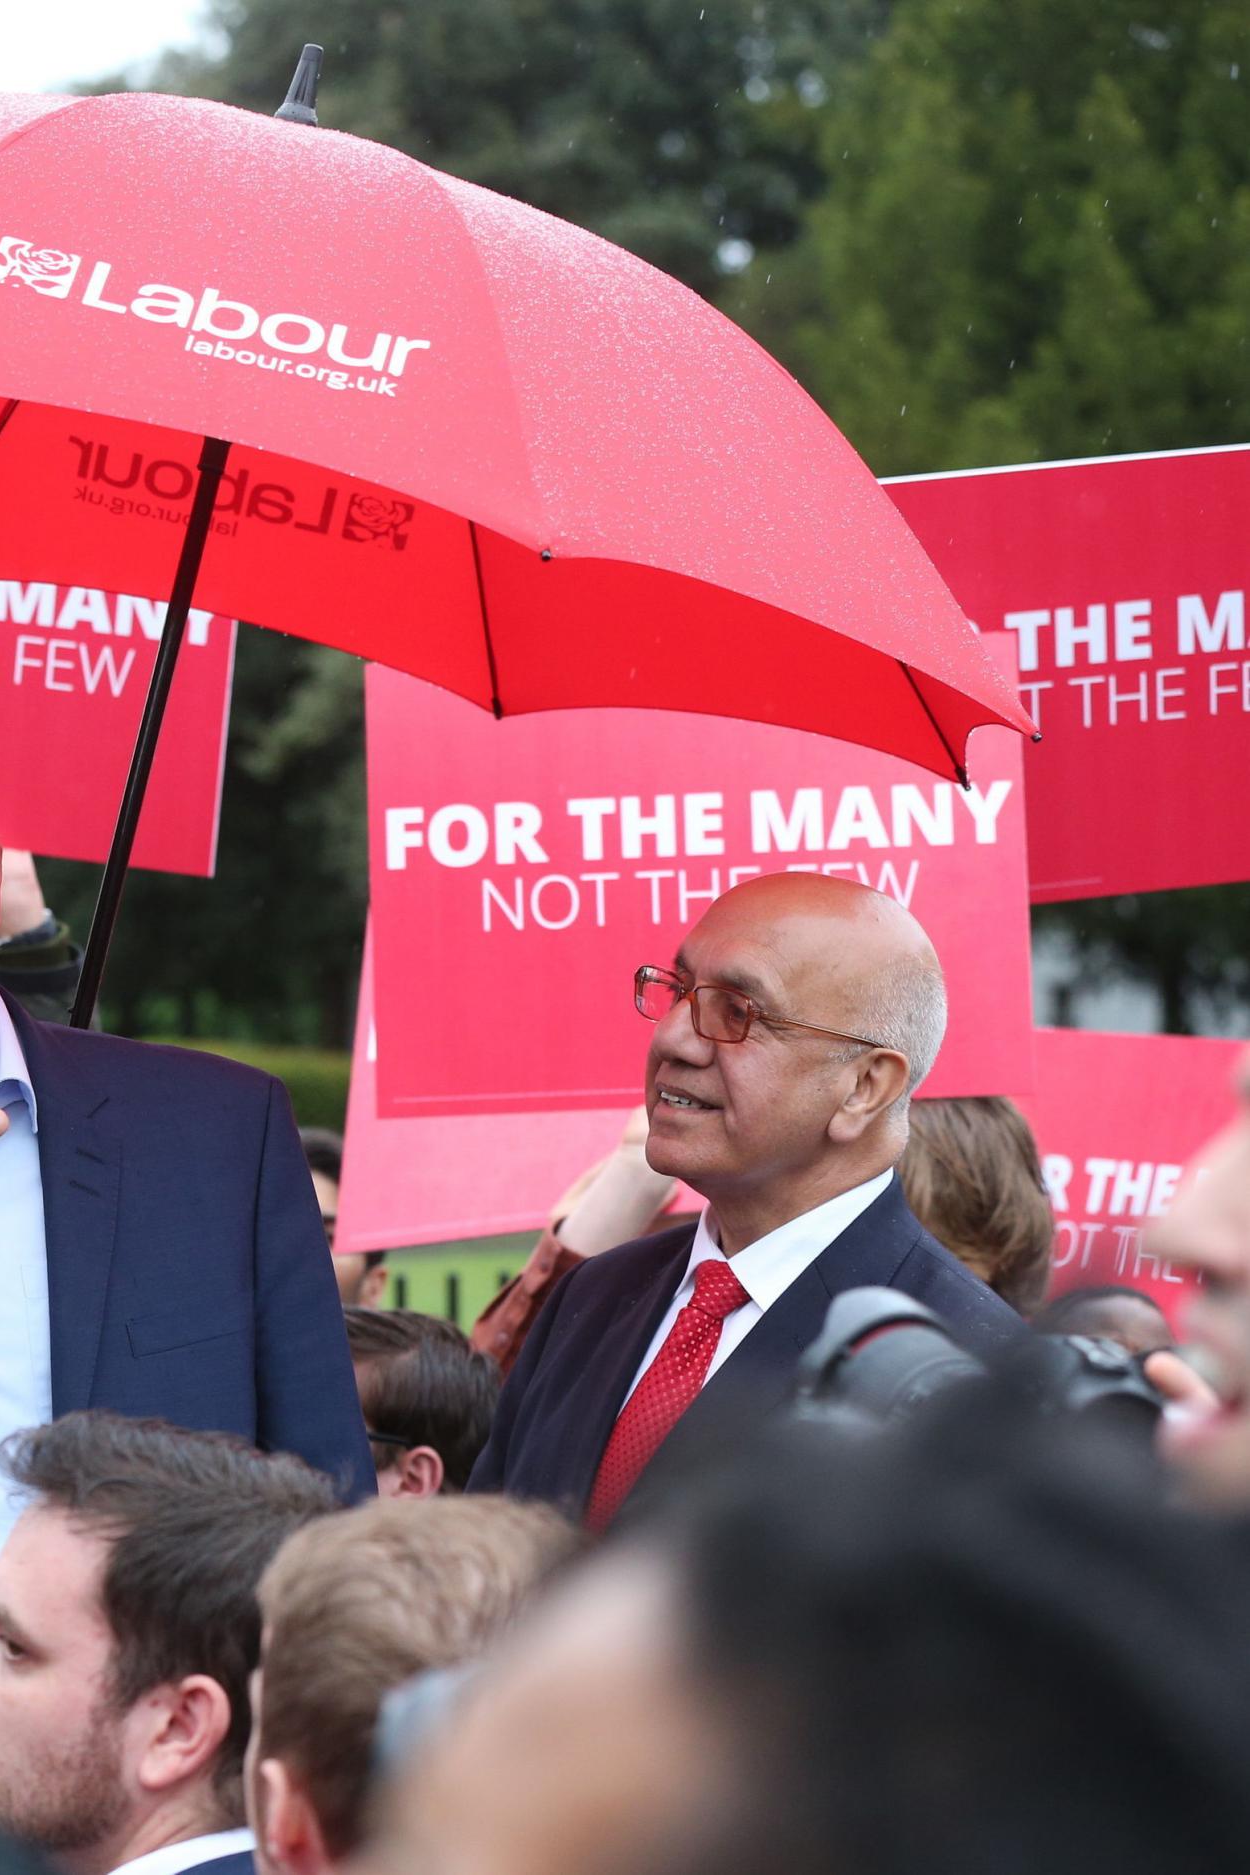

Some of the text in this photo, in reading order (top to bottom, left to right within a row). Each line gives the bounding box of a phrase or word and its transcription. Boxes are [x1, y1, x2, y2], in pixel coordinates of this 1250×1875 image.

[82, 261, 431, 377] Labour
[184, 335, 398, 397] labour.org.uk
[13, 634, 136, 698] FEW
[1004, 599, 1153, 672] THE
[1067, 667, 1187, 728] THE
[385, 780, 1013, 871] FOR THE MANY
[482, 872, 620, 932] NOT
